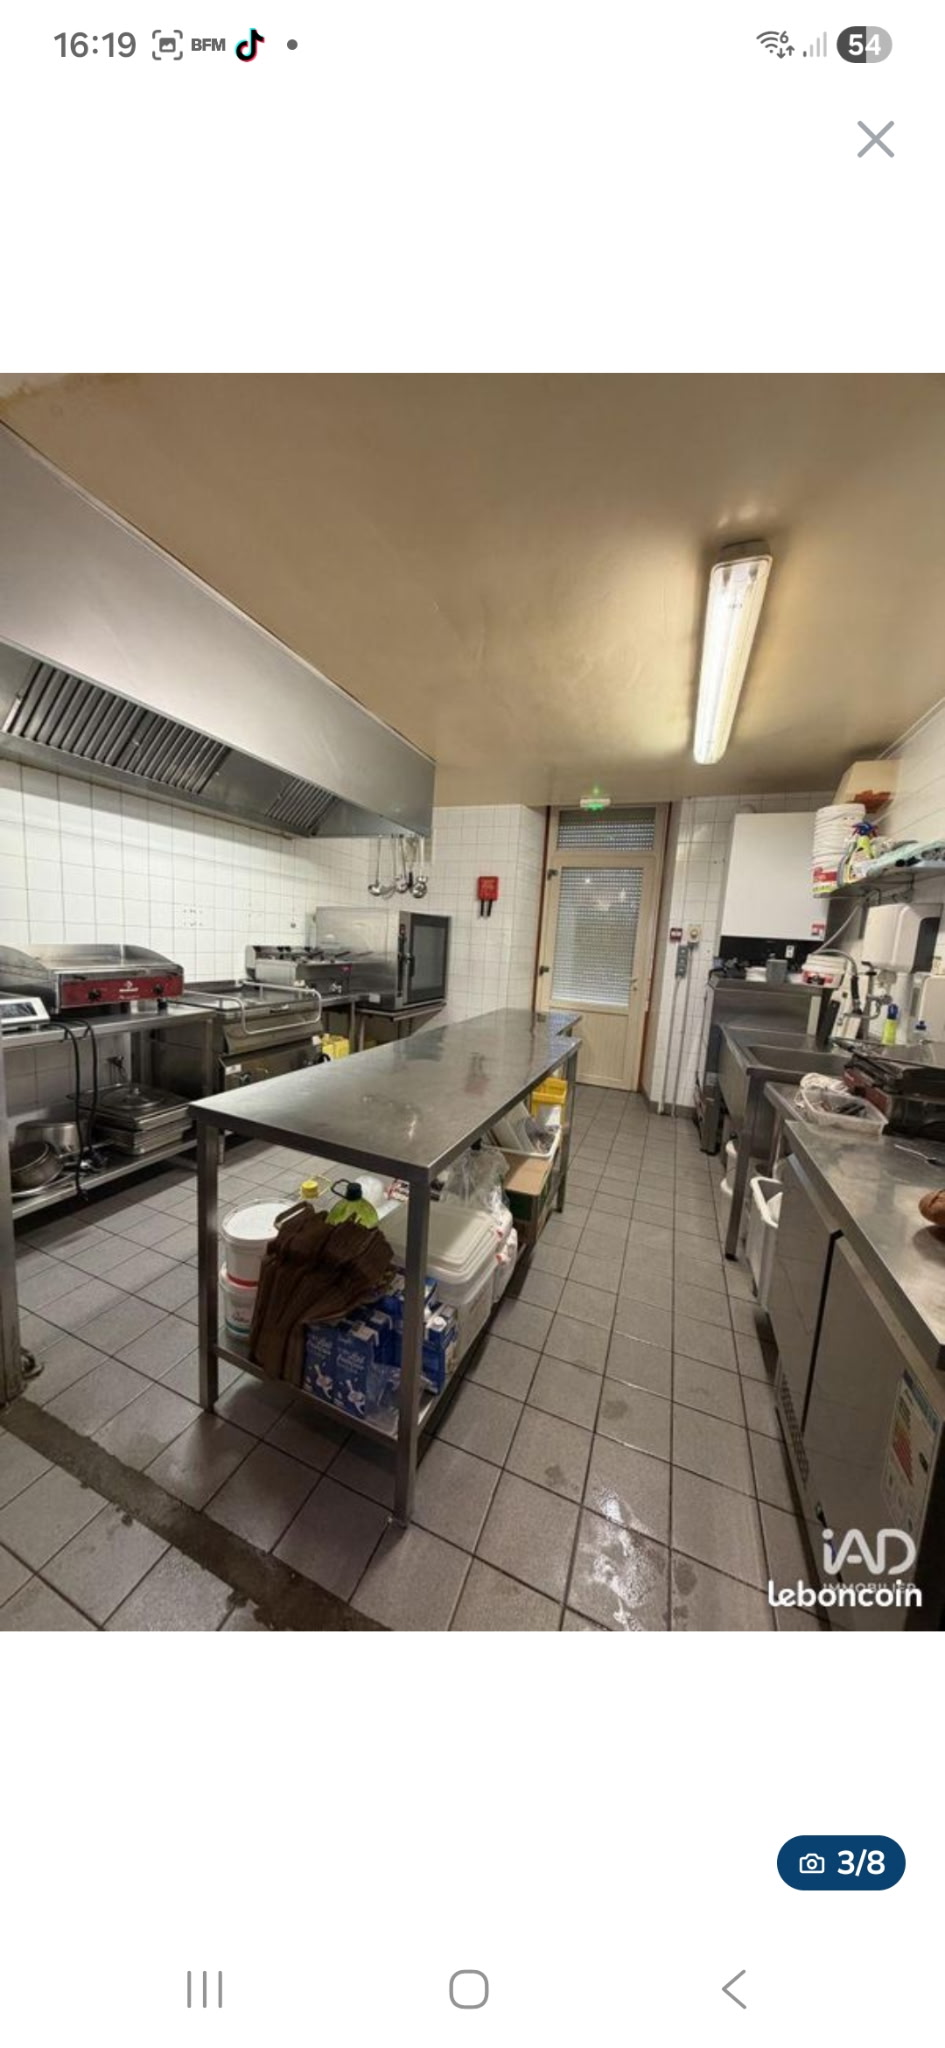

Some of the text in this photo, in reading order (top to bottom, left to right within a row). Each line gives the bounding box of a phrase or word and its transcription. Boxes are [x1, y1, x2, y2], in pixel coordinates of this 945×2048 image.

[54, 32, 136, 57] 16:19
[191, 37, 226, 52] BFM
[848, 33, 881, 56] 54
[837, 1849, 886, 1877] 3/8
